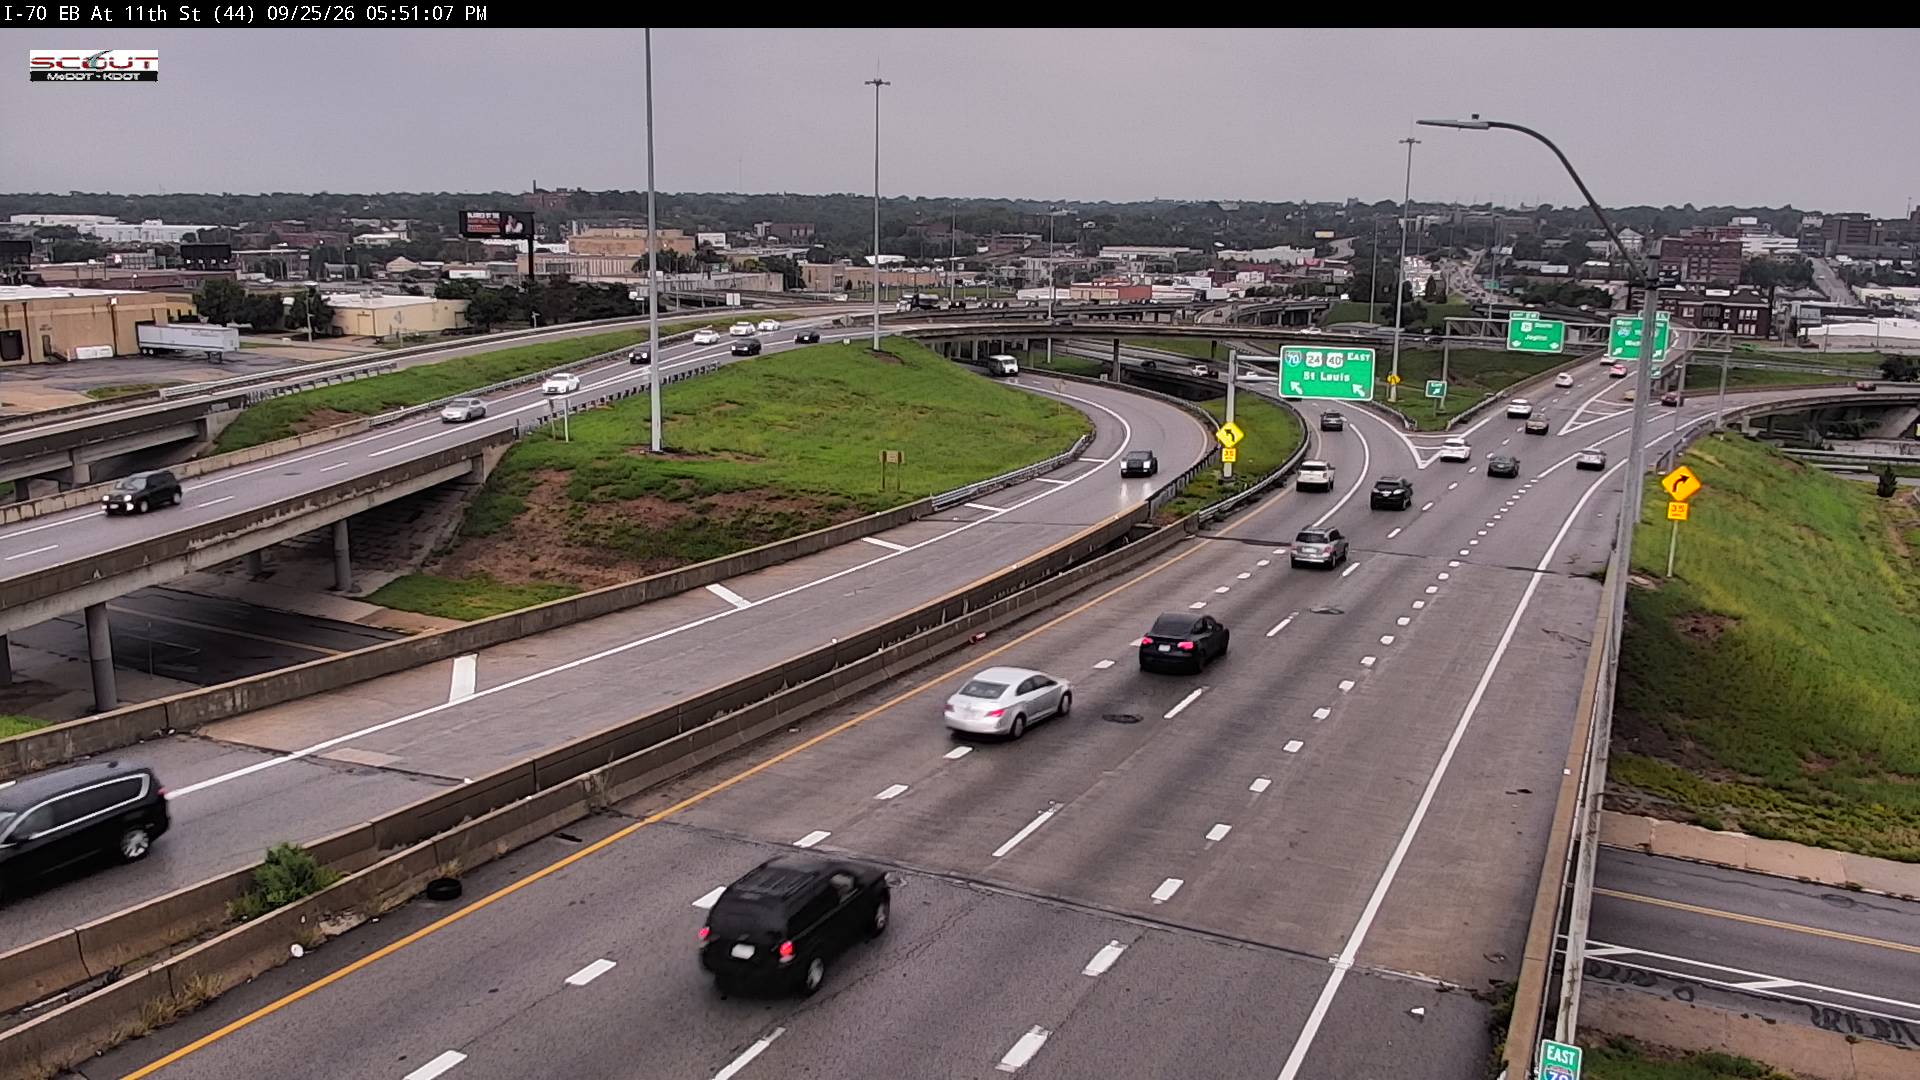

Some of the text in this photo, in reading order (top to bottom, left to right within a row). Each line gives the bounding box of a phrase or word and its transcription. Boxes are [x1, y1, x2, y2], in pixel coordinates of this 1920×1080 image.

[1308, 355, 1320, 364] 24
[1329, 356, 1342, 365] 40
[1347, 352, 1371, 361] EAST
[1303, 371, 1351, 382] St Louis
[1547, 1045, 1576, 1066] EAST
